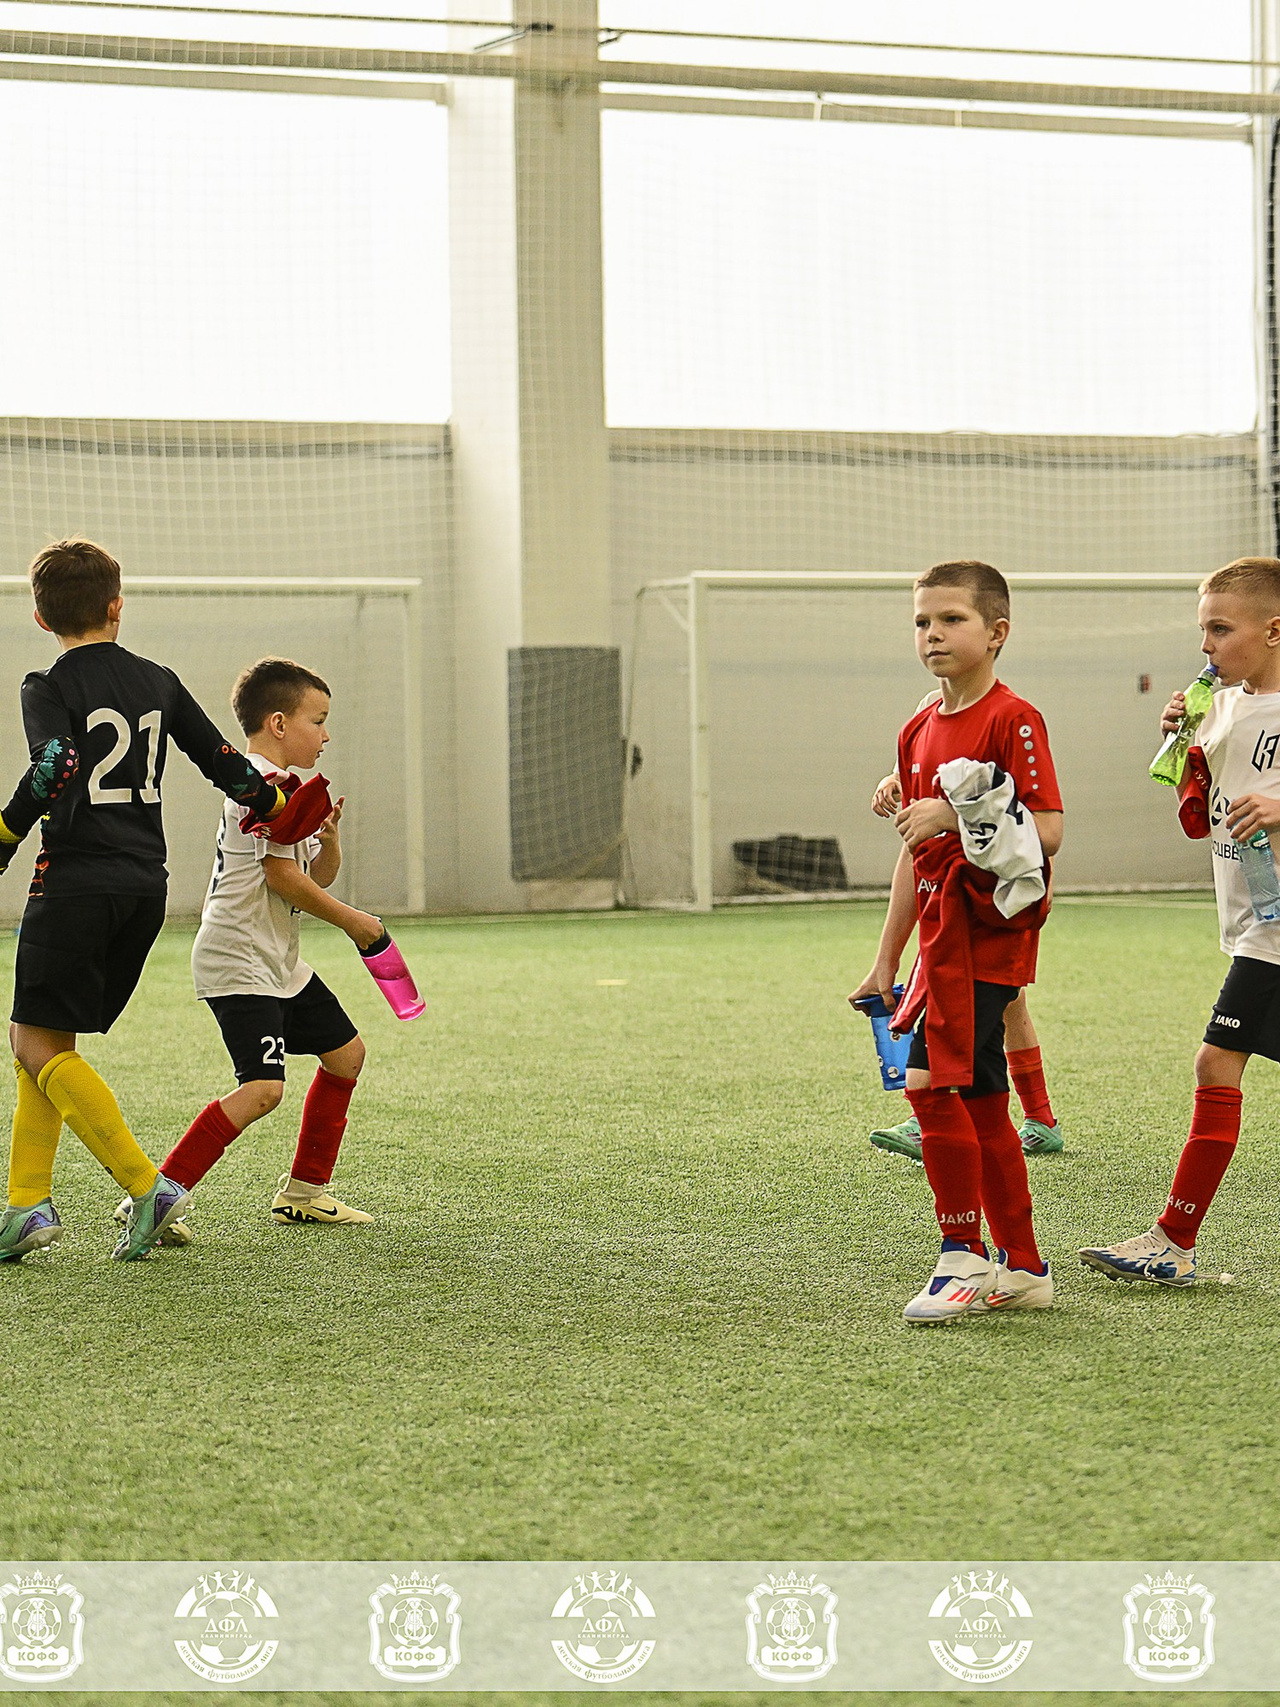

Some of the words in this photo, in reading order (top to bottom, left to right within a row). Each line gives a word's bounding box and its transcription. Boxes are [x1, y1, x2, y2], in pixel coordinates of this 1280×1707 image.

[86, 708, 162, 805] 21
[1214, 1014, 1241, 1029] JAKO
[260, 1035, 286, 1066] 23
[1167, 1195, 1197, 1215] AKO
[939, 1210, 977, 1225] JAKO
